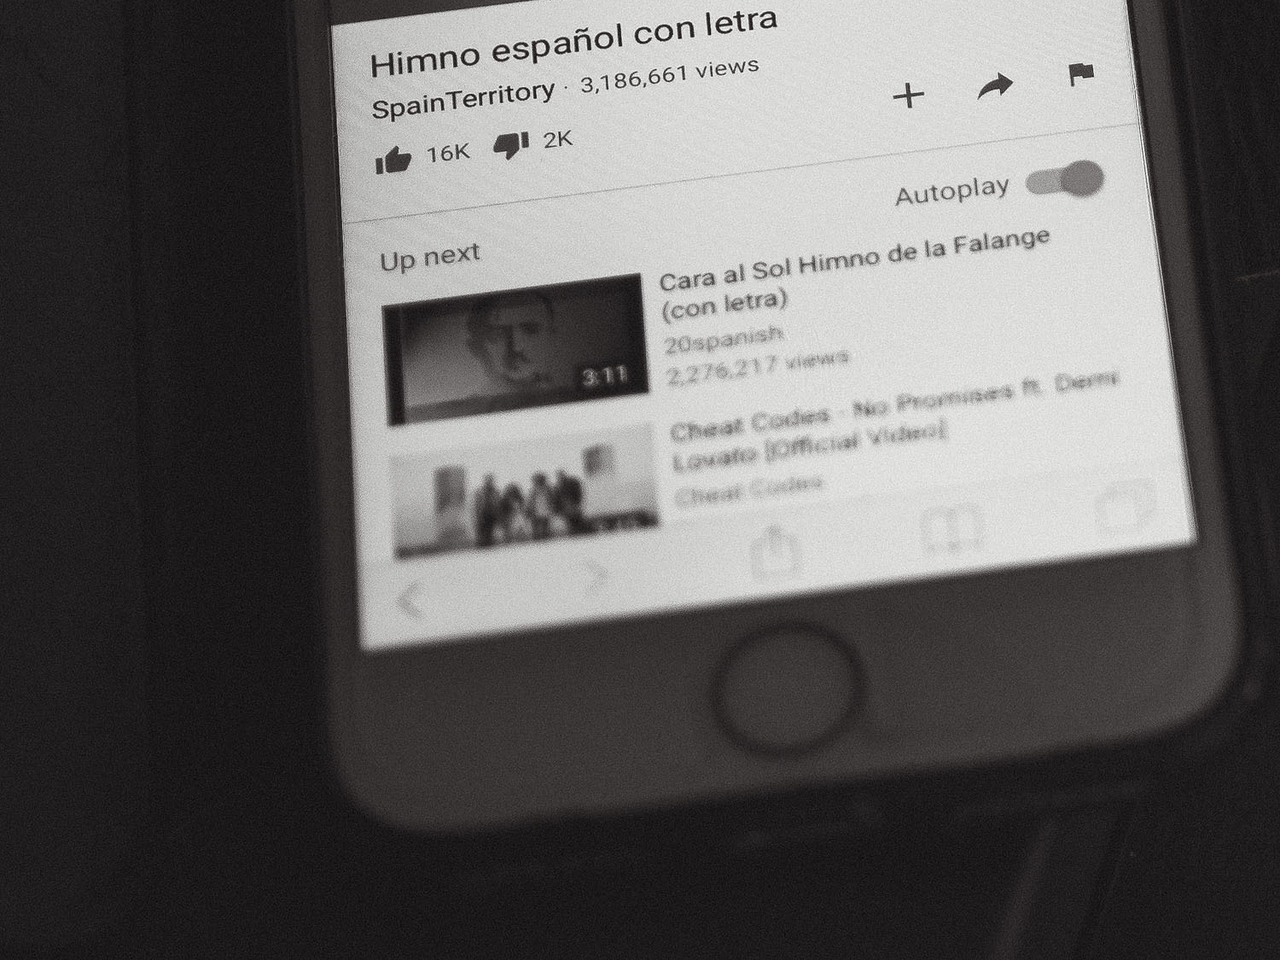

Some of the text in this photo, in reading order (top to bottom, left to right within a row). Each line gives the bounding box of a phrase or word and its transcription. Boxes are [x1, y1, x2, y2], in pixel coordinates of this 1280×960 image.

[370, 8, 778, 78] Himno español con letra
[372, 81, 556, 122] SpainTerritory
[580, 64, 688, 96] 3,186,661
[694, 57, 761, 80] views
[426, 129, 574, 163] 16K 2K
[895, 176, 1010, 207] Autoplay
[380, 241, 481, 274] Up next
[660, 227, 1051, 291] Cara al Sol Himno de la Falange
[661, 287, 789, 324] (con letra)
[664, 324, 785, 356] 20spanish
[581, 365, 629, 388] 3:11
[666, 348, 851, 388] 2,276,217 views
[670, 418, 746, 444] Cheat
[750, 407, 831, 432] Codes
[852, 399, 889, 419] No
[896, 384, 1016, 414] Promises
[1053, 369, 1122, 394] Demi
[673, 445, 759, 474] Lovato
